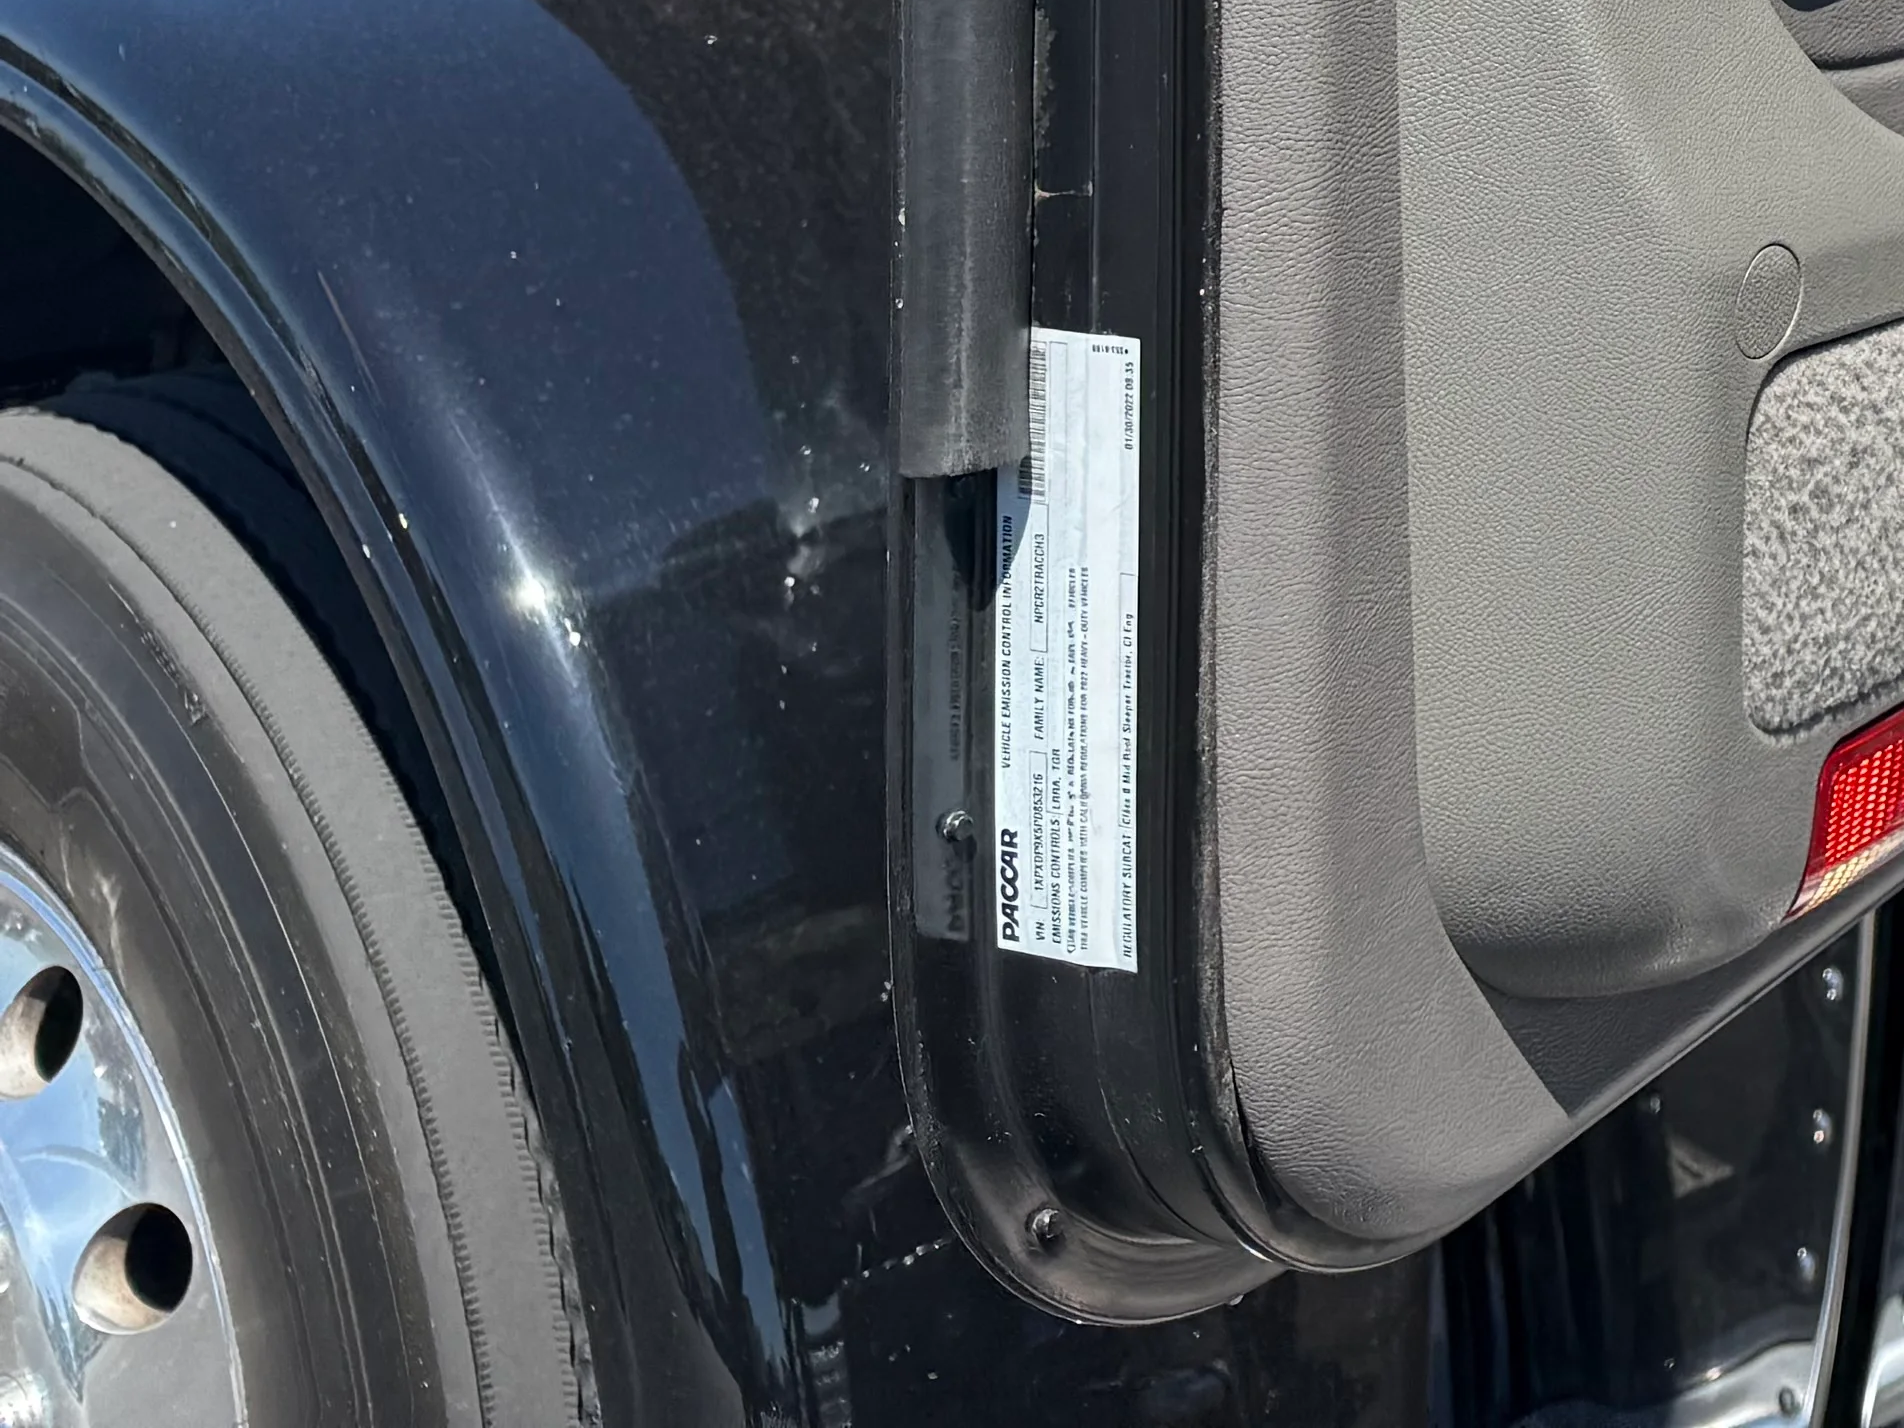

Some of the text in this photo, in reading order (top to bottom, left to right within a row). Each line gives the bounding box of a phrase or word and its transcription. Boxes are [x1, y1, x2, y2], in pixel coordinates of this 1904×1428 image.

[1001, 516, 1013, 769] VEHICLE EMISSION CONTROL INFORMATION
[1123, 613, 1134, 633] Eng
[1034, 698, 1044, 740] FAMILY
[1000, 828, 1019, 942] PACCAR
[1051, 883, 1061, 944] EMISSIONS
[1122, 882, 1133, 958] REGULATORY
